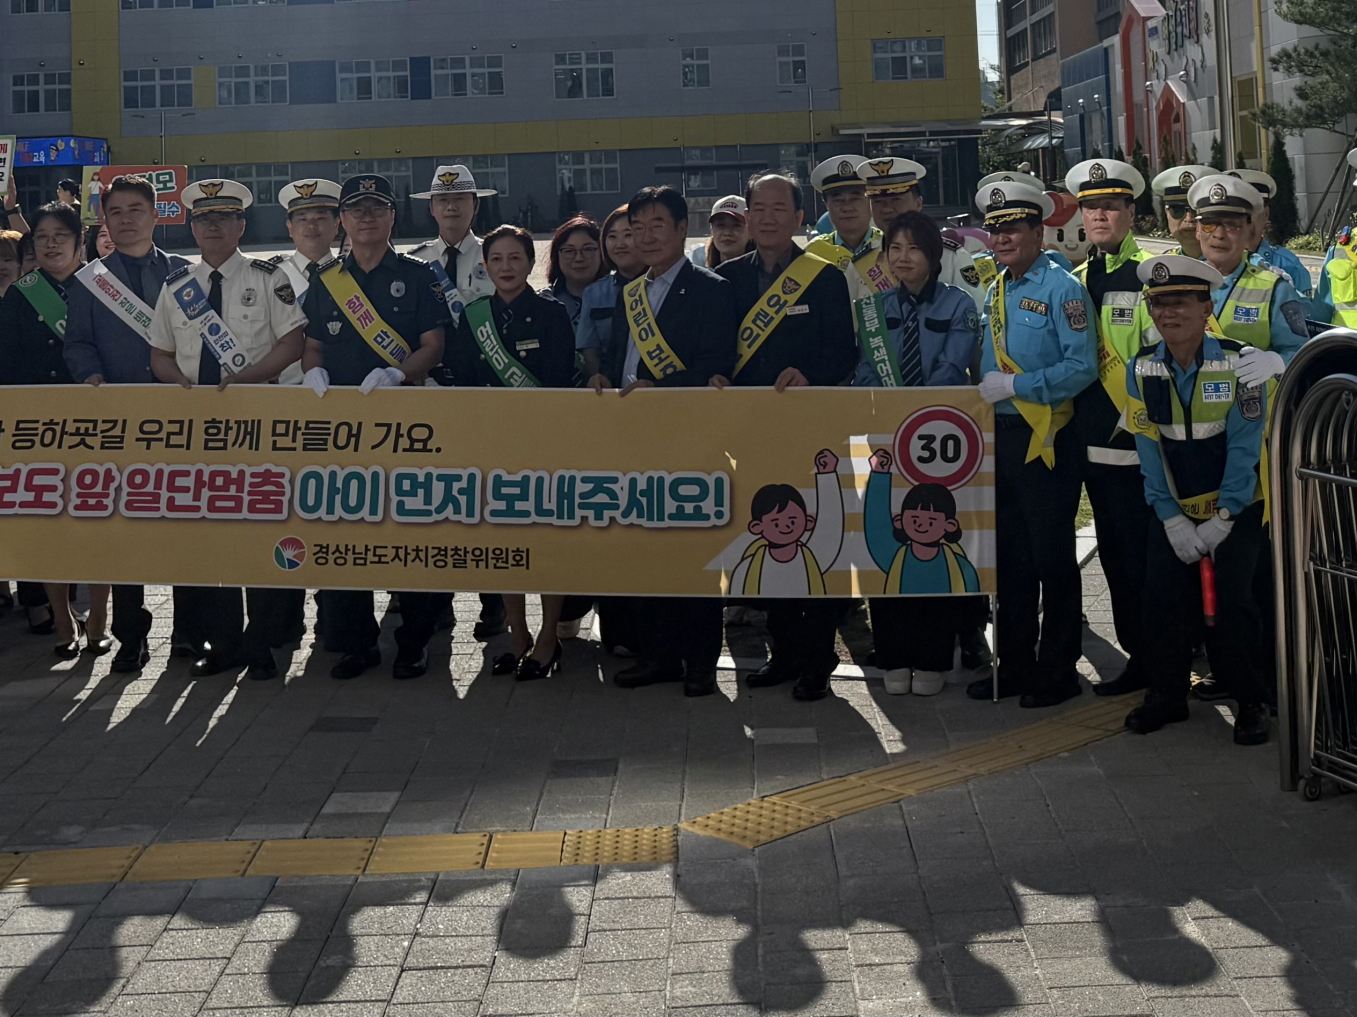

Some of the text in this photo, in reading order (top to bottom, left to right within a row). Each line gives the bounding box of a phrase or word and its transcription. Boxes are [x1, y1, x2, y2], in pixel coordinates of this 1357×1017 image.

[345, 293, 376, 330] 함께
[629, 295, 655, 342] 어린이
[740, 292, 789, 350] 어린이
[477, 320, 509, 371] 어린이
[1204, 383, 1229, 392] 모범
[10, 418, 128, 452] 등하굣길
[135, 418, 194, 451] 우리
[202, 417, 262, 452] 함께
[270, 418, 363, 454] 만들어
[370, 420, 443, 455] 가요.
[916, 433, 962, 464] 30
[72, 466, 117, 515] 앞
[123, 464, 288, 517] 일단멈춤
[297, 468, 382, 519] 아이
[392, 470, 478, 521] 먼저
[488, 472, 727, 525] 보내주세요!
[312, 543, 531, 570] 경상남도자치경찰위원회
